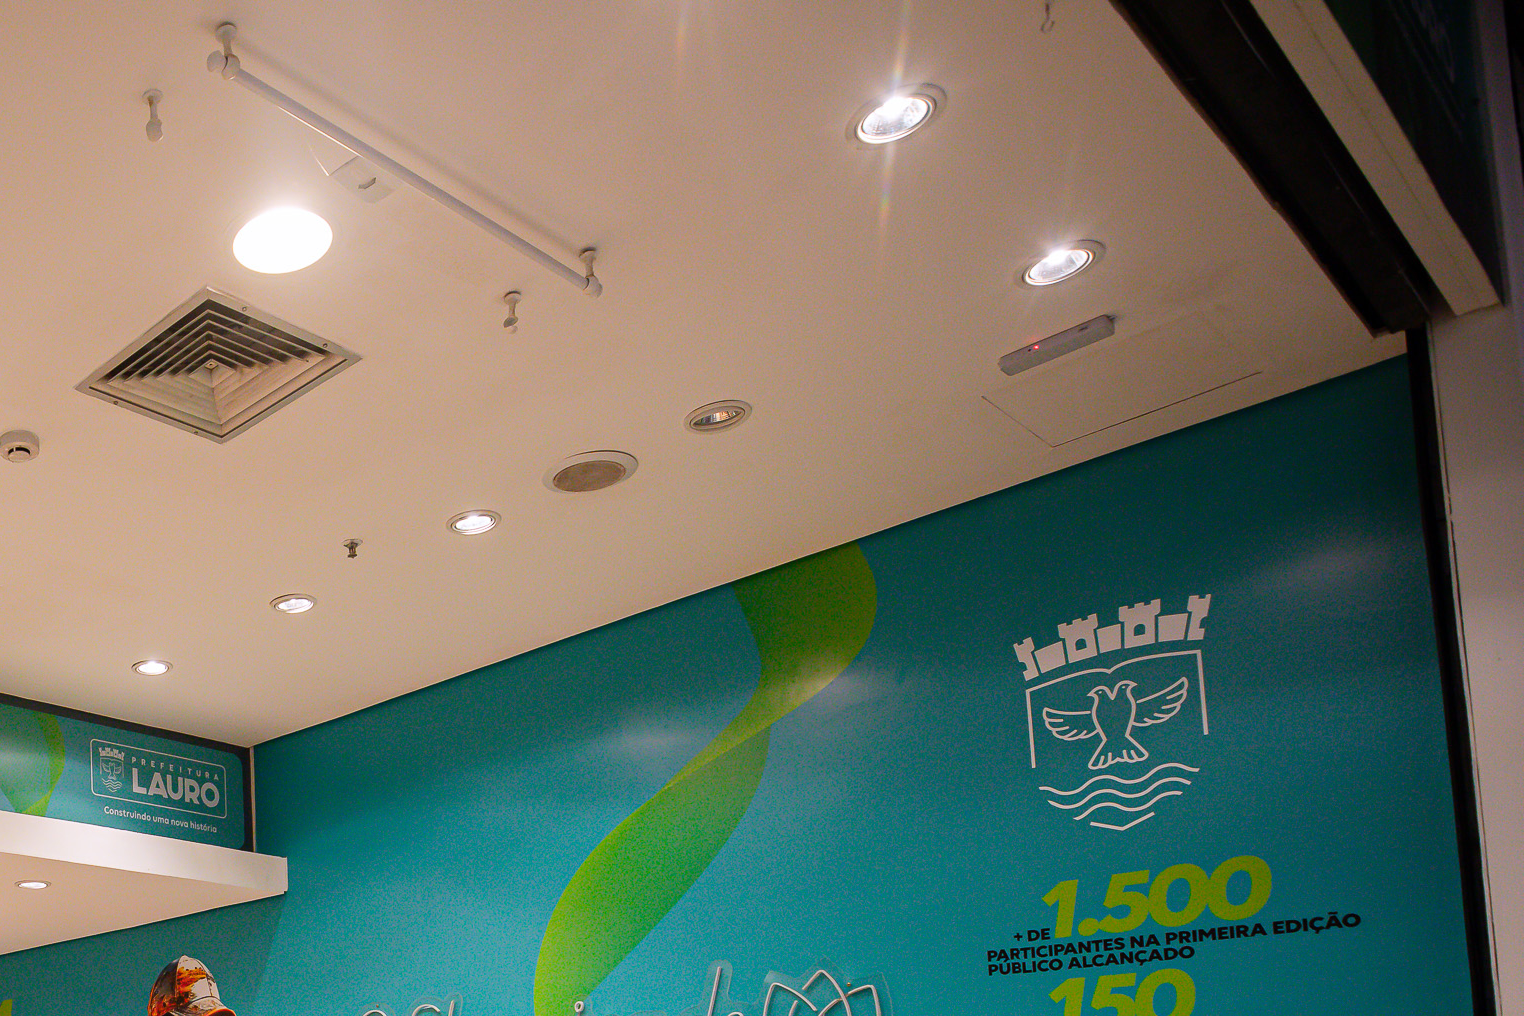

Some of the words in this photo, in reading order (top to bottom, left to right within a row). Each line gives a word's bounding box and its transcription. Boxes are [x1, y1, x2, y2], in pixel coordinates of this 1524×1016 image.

[131, 756, 219, 781] PREFEITURA
[131, 767, 220, 808] LAURO
[103, 805, 151, 822] Construindo
[152, 815, 170, 825] uma
[171, 818, 189, 828] nova
[189, 820, 218, 833] história
[1027, 928, 1051, 942] DE
[1042, 855, 1273, 939] 1.500
[986, 937, 1126, 964] PARTICIPANTES
[1130, 934, 1161, 950] NA
[1165, 923, 1268, 945] PRIMEIRA
[1272, 911, 1362, 934] EDIÇÃO
[988, 956, 1064, 976] PÚBLICO
[1067, 945, 1196, 971] ALCANÇADO
